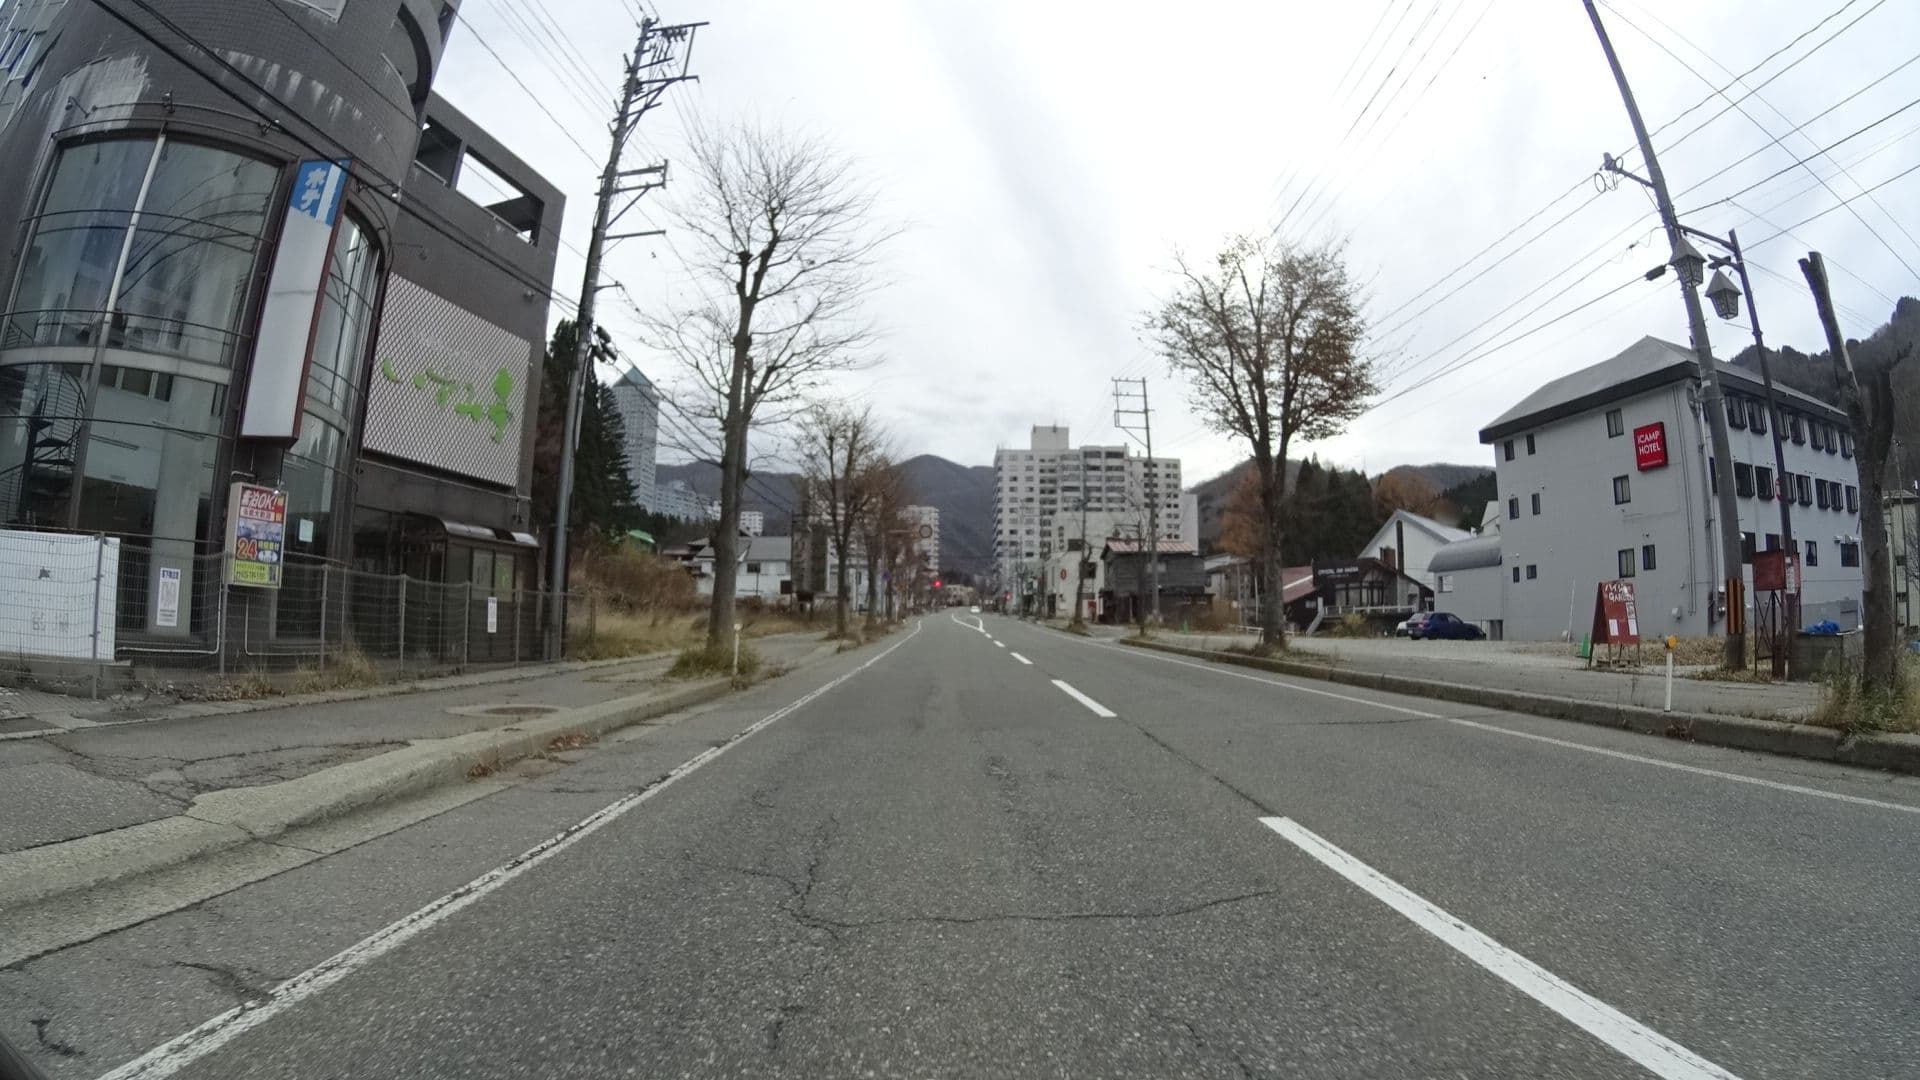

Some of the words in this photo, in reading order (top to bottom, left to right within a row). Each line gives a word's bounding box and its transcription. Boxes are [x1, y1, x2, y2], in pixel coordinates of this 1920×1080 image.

[300, 167, 327, 215] ホテ
[1638, 441, 1660, 455] HOTEL
[237, 537, 258, 560] 24
